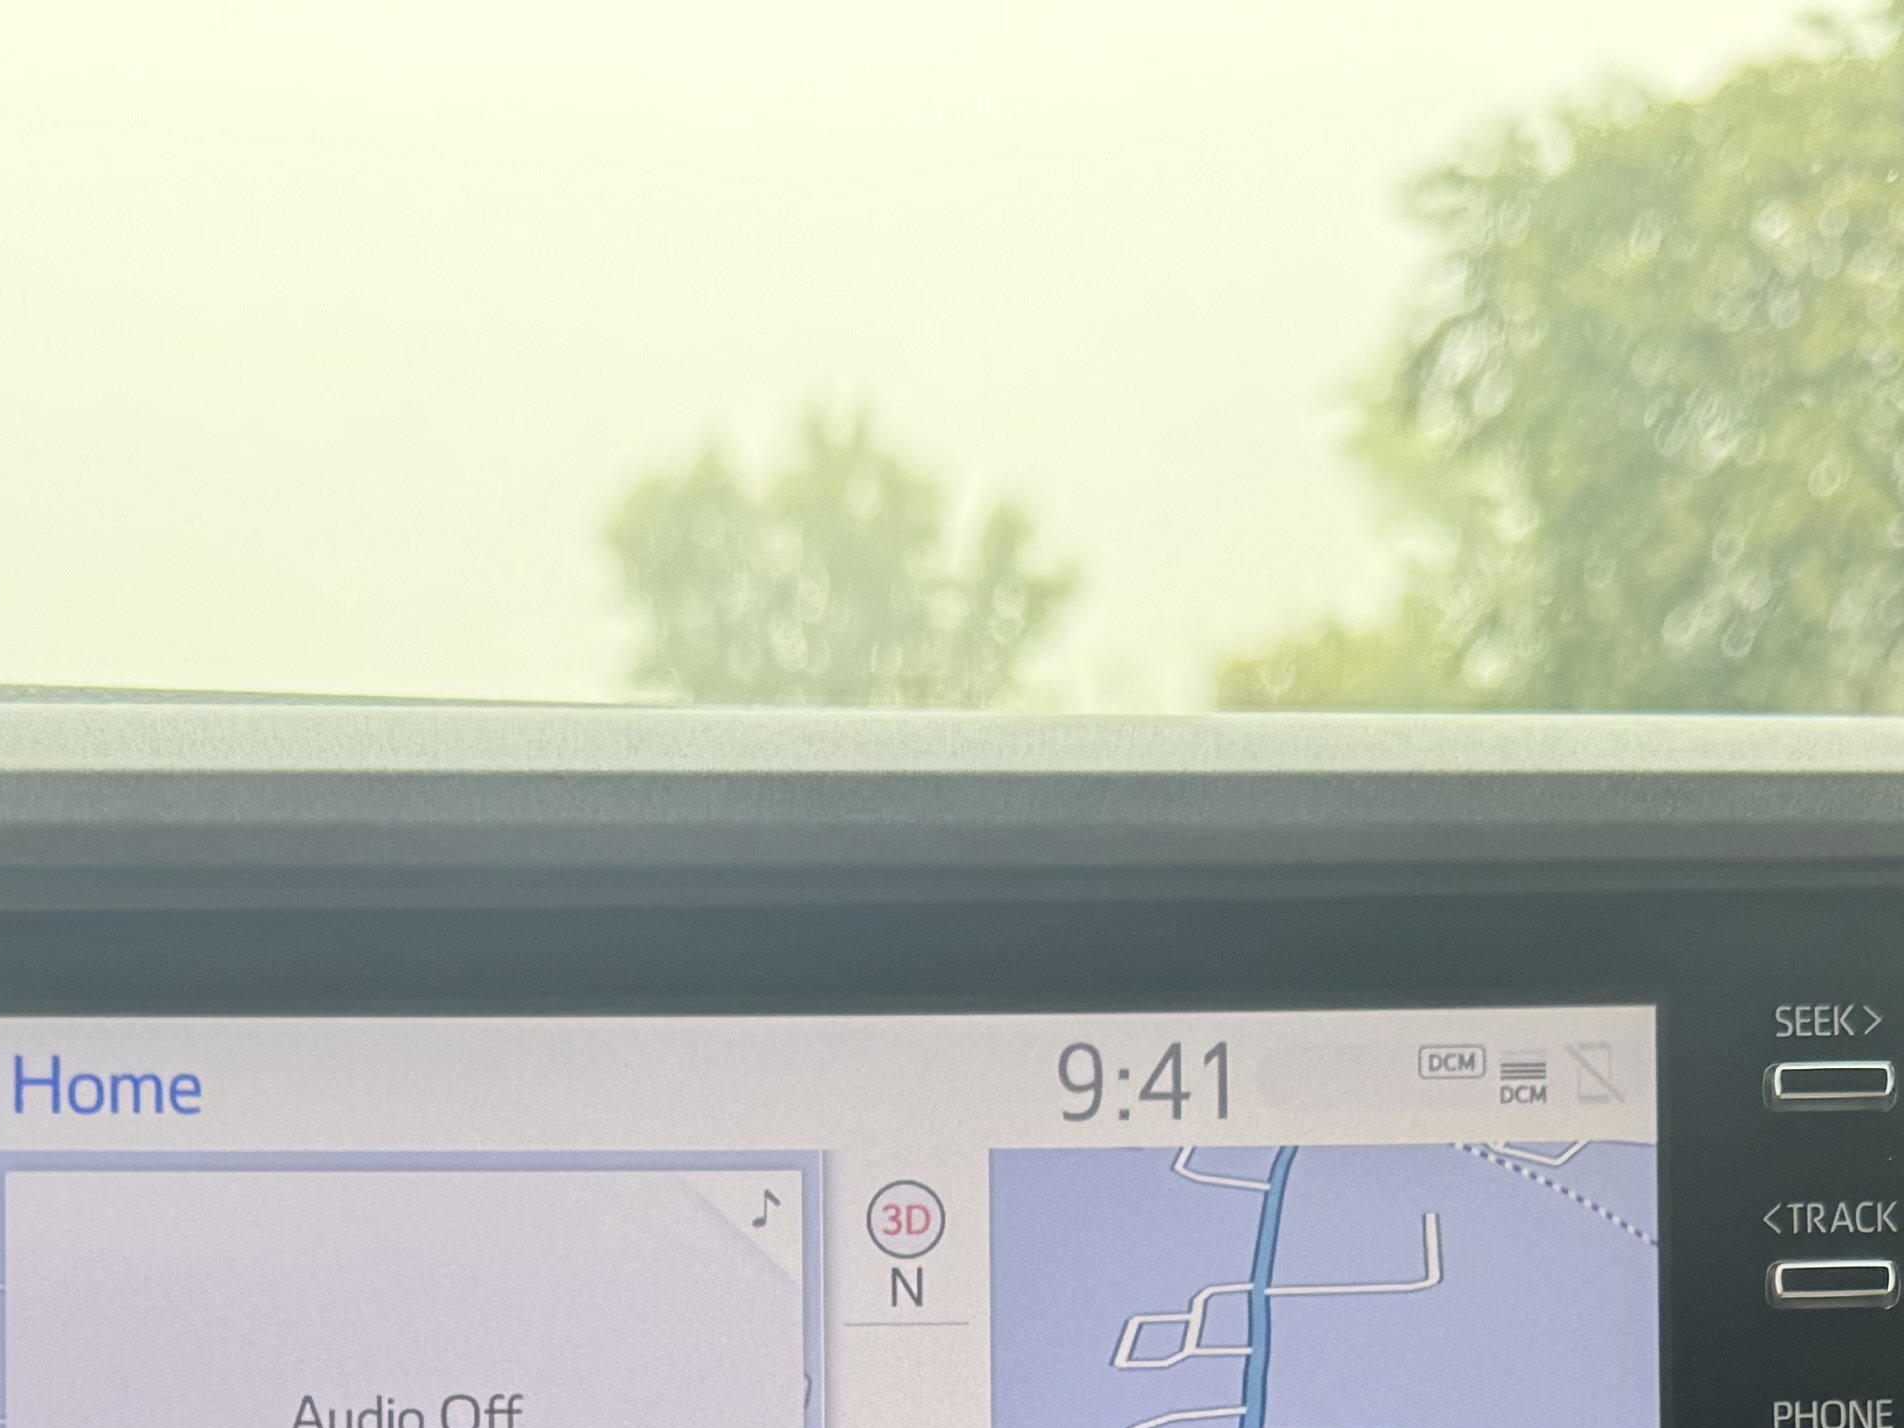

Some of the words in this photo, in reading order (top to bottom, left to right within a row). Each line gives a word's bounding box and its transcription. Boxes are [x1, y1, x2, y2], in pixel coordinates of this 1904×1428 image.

[1775, 1004, 1855, 1038] SEEK
[1428, 1052, 1476, 1074] DCM
[13, 1054, 202, 1116] Home
[1057, 1040, 1229, 1122] 9:41
[1499, 1084, 1548, 1104] DCM
[881, 1204, 931, 1237] 3D
[1790, 1200, 1899, 1234] TRACK
[890, 1266, 924, 1309] N
